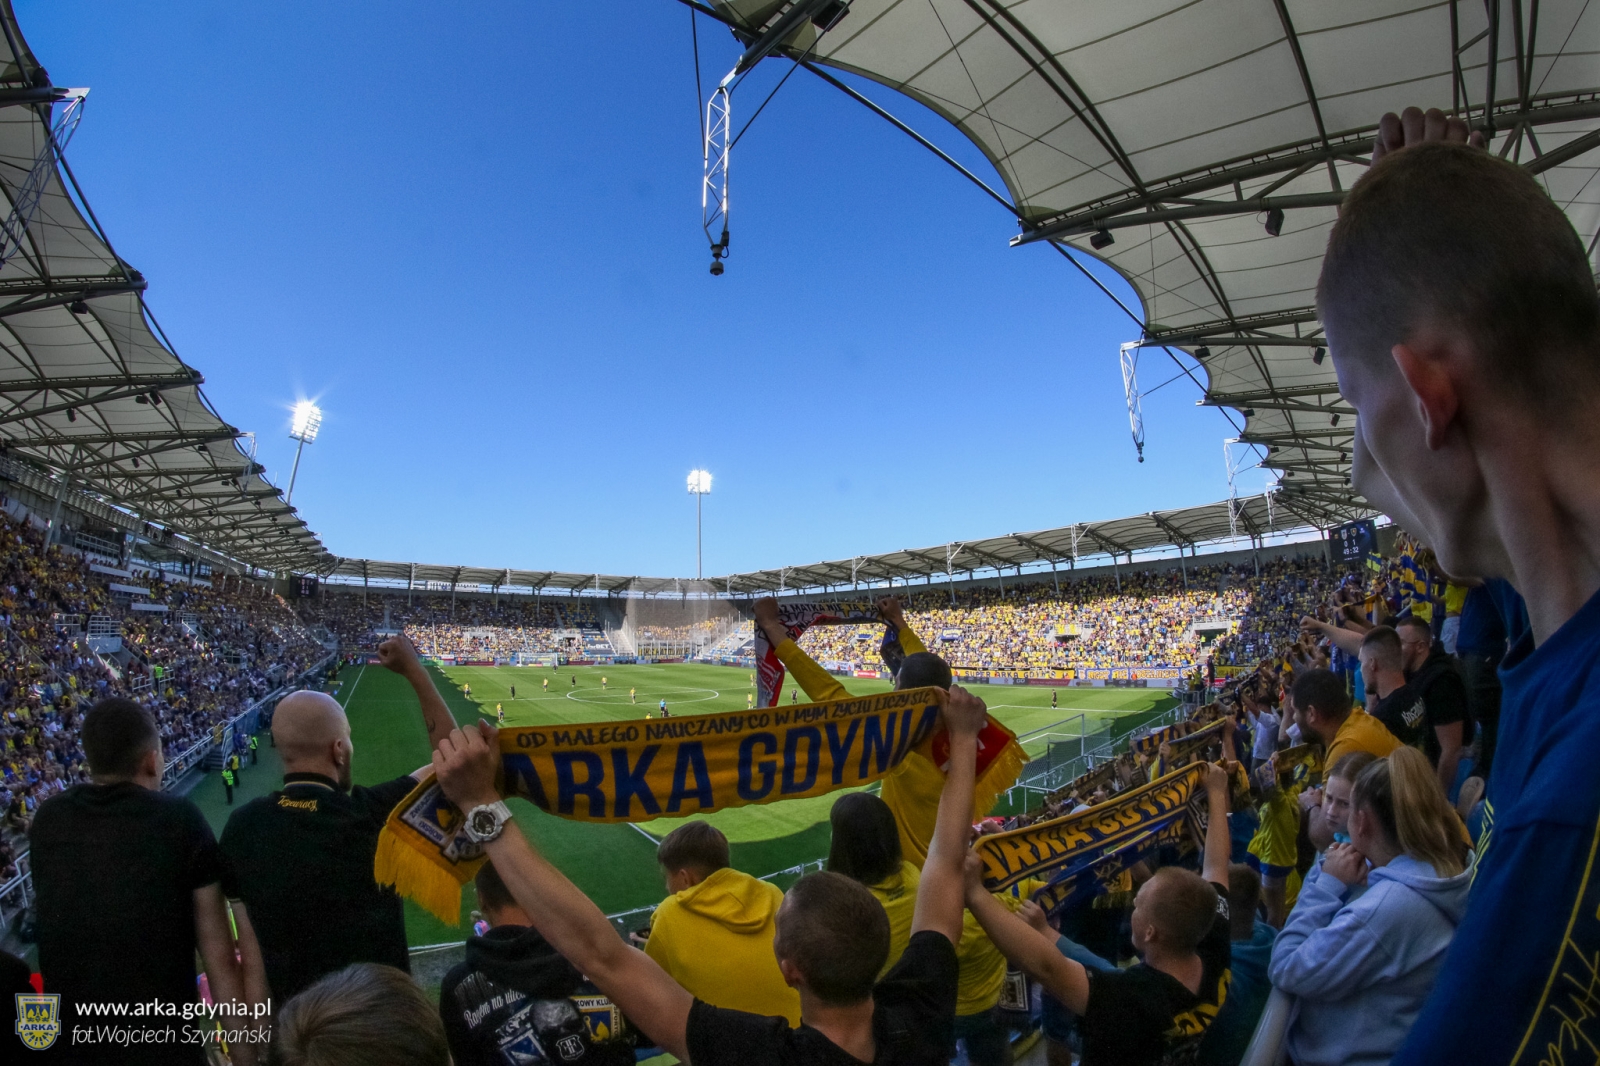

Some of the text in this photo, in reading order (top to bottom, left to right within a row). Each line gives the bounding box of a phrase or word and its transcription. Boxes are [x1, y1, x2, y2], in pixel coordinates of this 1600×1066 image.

[790, 603, 825, 613] MATKA
[827, 603, 844, 612] NIE
[848, 603, 860, 611] TA
[516, 731, 547, 748] OD
[553, 726, 639, 746] MAŁEGO
[645, 713, 744, 741] NAUCZANY
[749, 713, 769, 730] CO
[775, 711, 791, 726] W
[793, 706, 829, 723] MYM
[832, 697, 873, 717] ŻYCIU
[874, 692, 911, 712] LICZY
[501, 740, 715, 818] ARKA
[982, 823, 1094, 882] ARKA
[463, 1001, 491, 1029] Razem
[490, 995, 504, 1011] na
